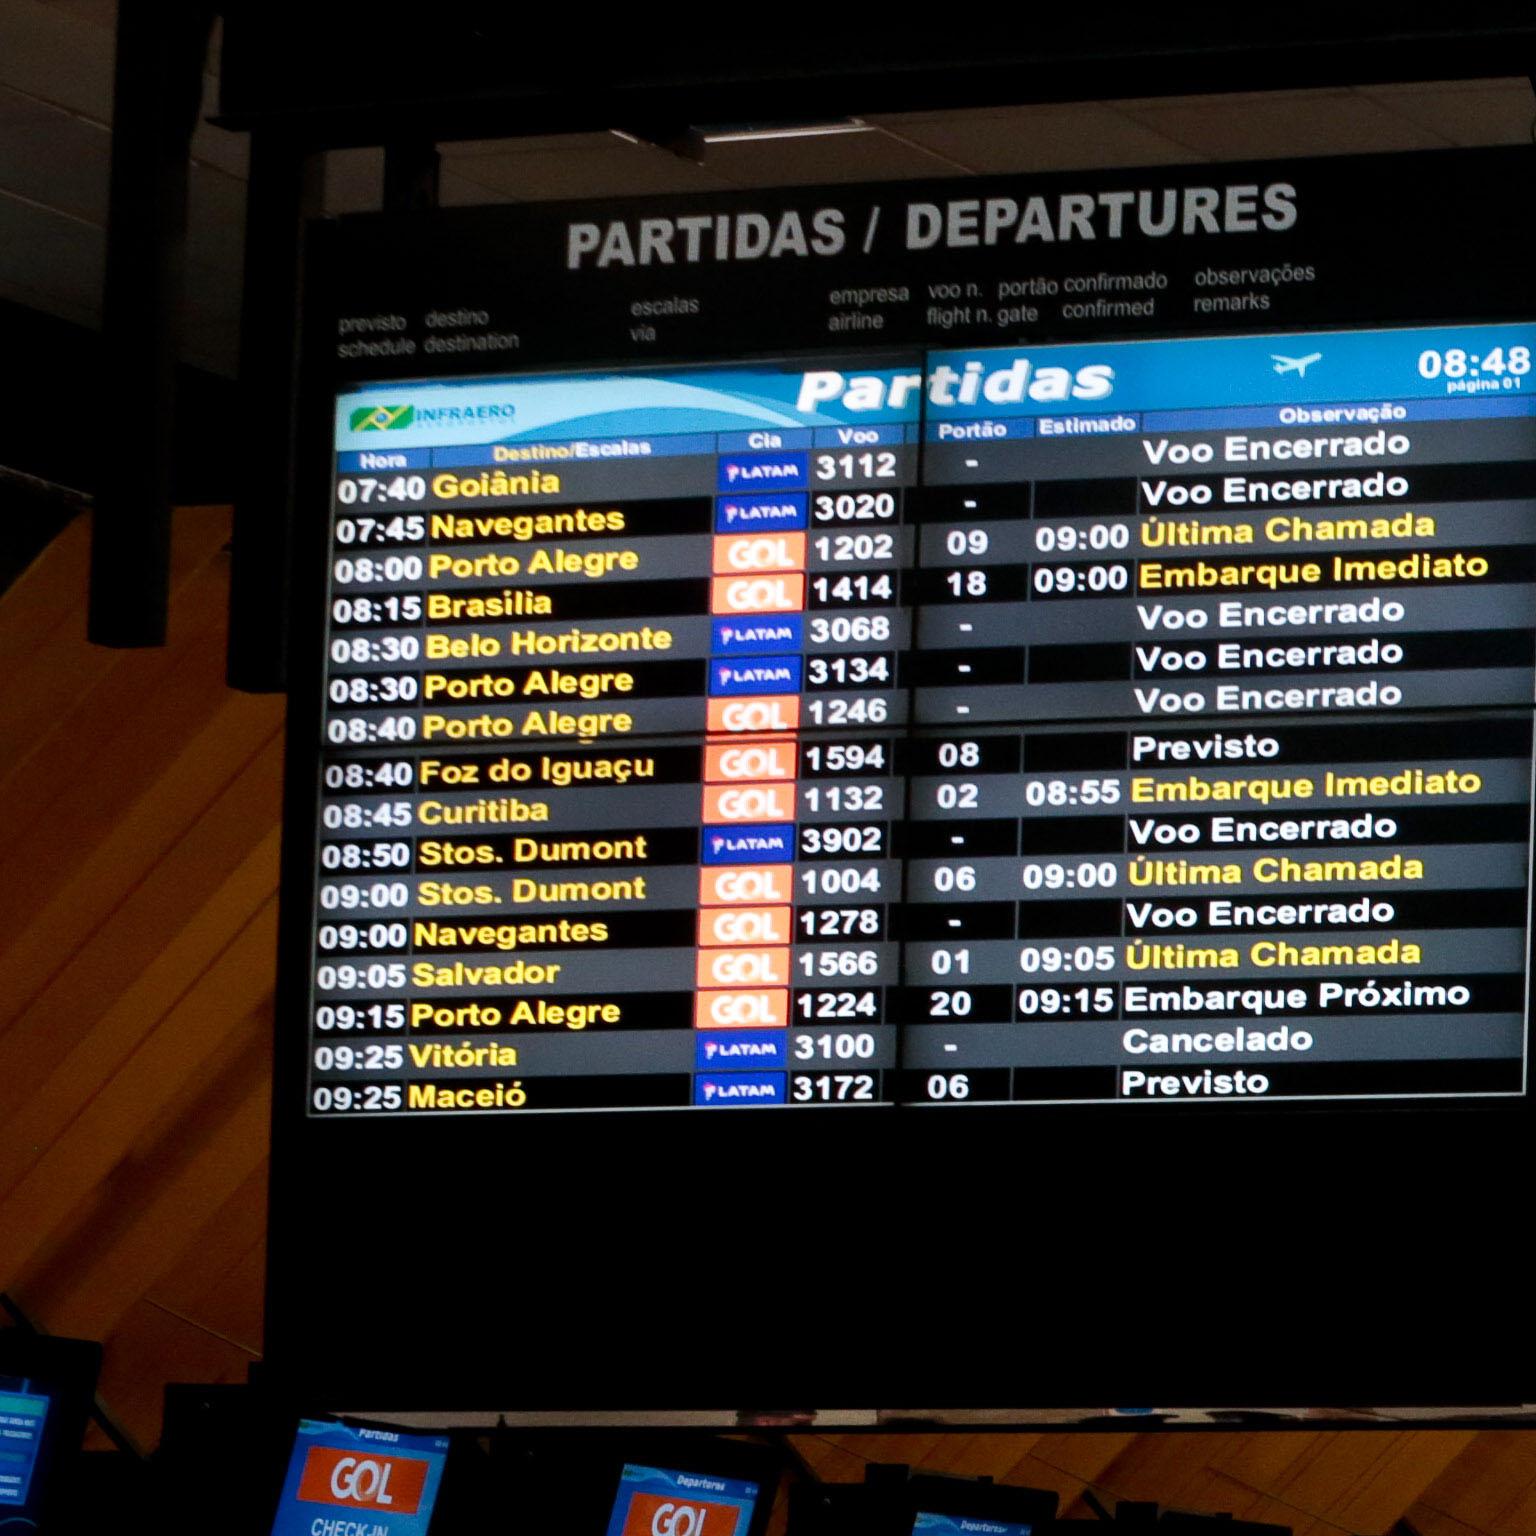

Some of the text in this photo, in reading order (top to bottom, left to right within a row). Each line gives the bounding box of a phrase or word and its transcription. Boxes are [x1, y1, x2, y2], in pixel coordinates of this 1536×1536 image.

[567, 207, 846, 270] PARTIDAS
[906, 183, 1298, 251] DEPARTURES
[1142, 430, 1411, 466] Voo Encerrado
[740, 463, 799, 480] LATAM
[816, 451, 896, 481] 3112
[338, 475, 426, 505] 07:40
[432, 469, 560, 500] Goiânia
[946, 529, 989, 556] 09
[1035, 524, 1130, 553] 09:00
[1140, 511, 1436, 548] Última Chamada
[728, 538, 795, 570] GOL
[814, 533, 894, 562] 1202
[334, 556, 422, 585] 08:00
[429, 545, 639, 581] Porto Alegre
[409, 1039, 517, 1068] Vitória
[718, 1041, 777, 1057] LATAM
[794, 1033, 875, 1060] 3100
[1122, 1027, 1313, 1055] Cancelado
[315, 1043, 403, 1072] 09:25
[330, 1457, 393, 1505] GOL
